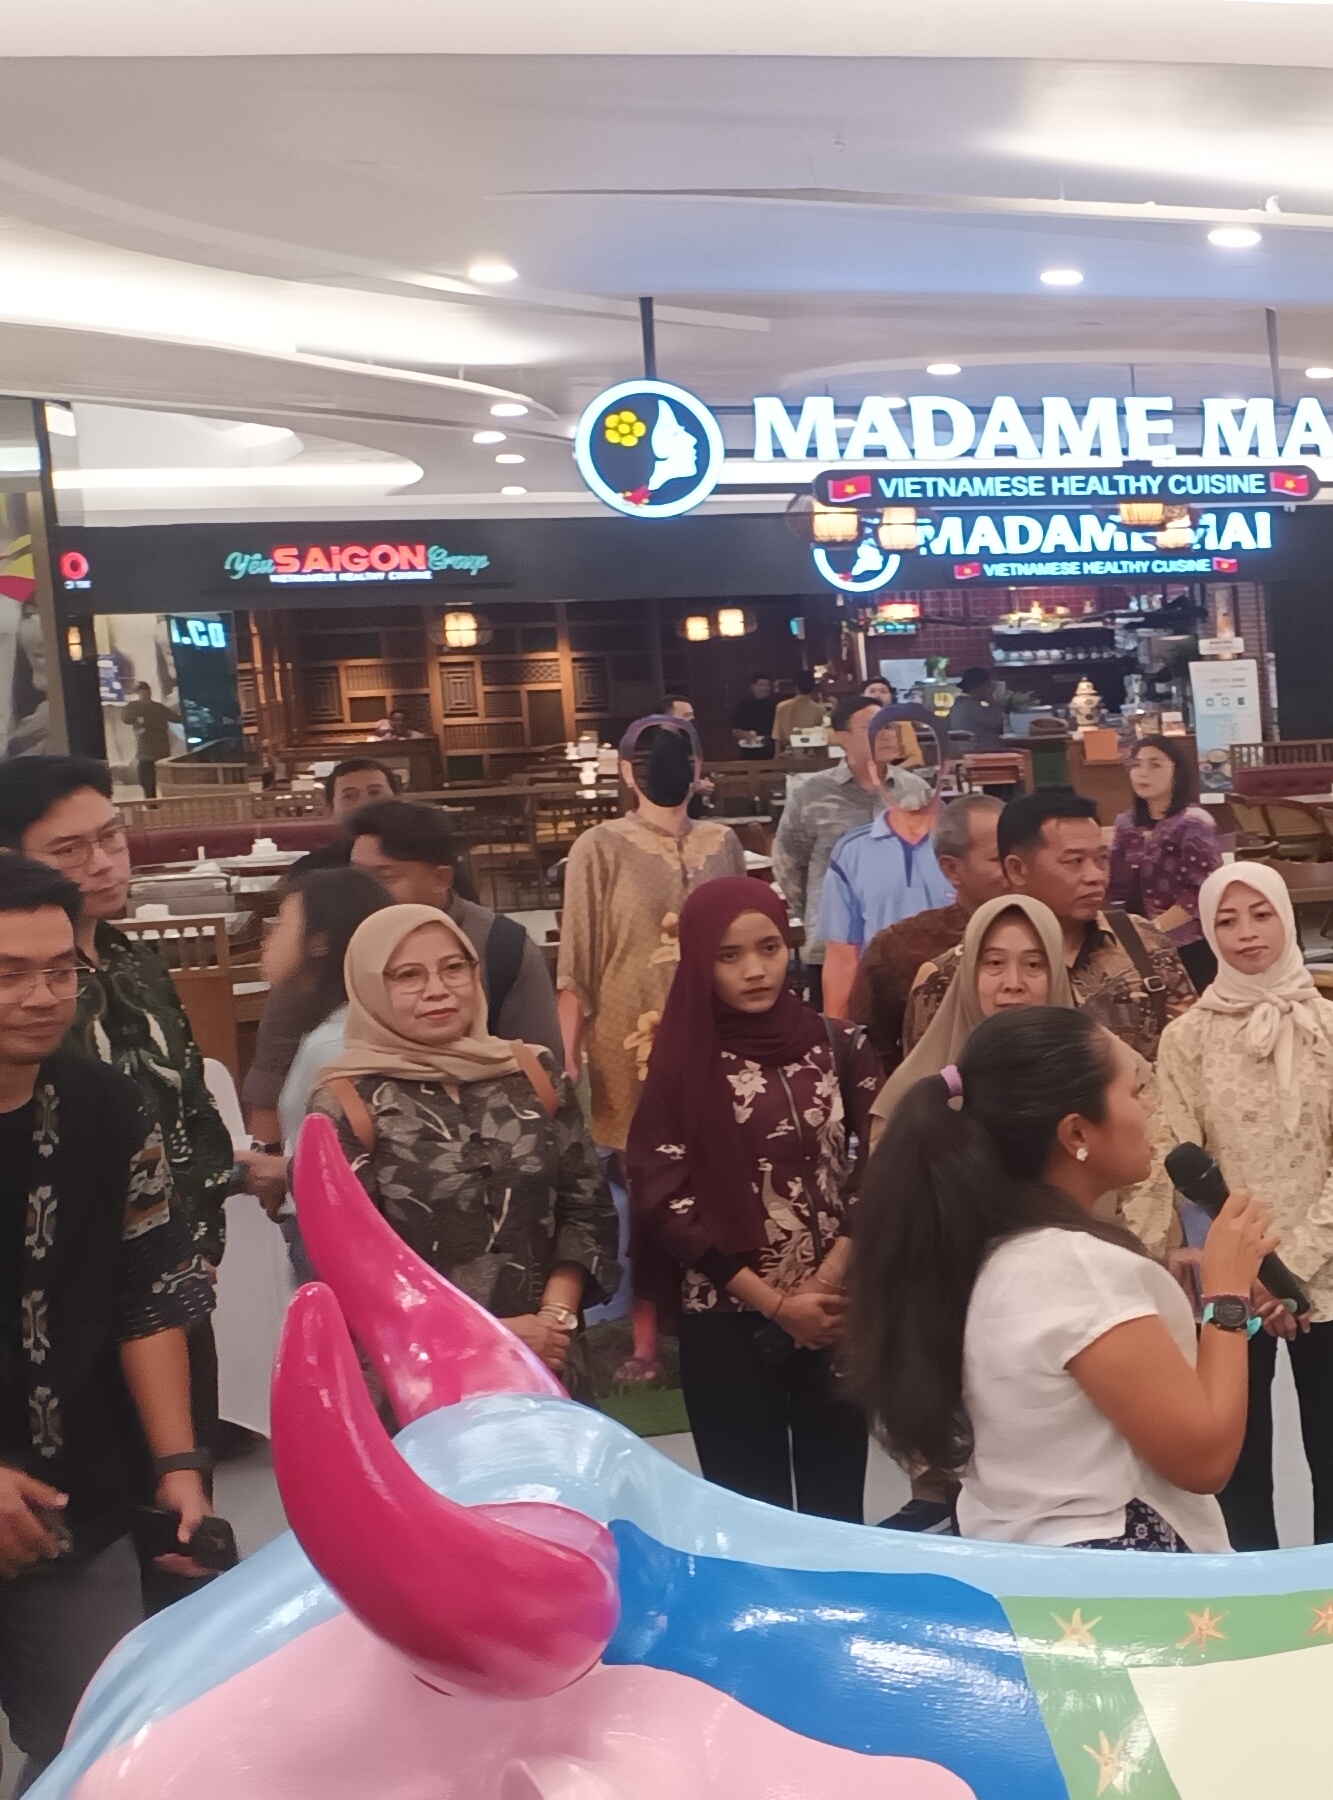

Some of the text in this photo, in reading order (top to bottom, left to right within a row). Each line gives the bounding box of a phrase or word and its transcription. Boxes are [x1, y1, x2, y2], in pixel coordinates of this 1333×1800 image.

[754, 395, 1177, 461] MADAME
[879, 473, 1266, 498] VIETNAMESE HEALTHY CUISINE
[984, 558, 1211, 577] VIETNAMESE HEALTHY CUISINE
